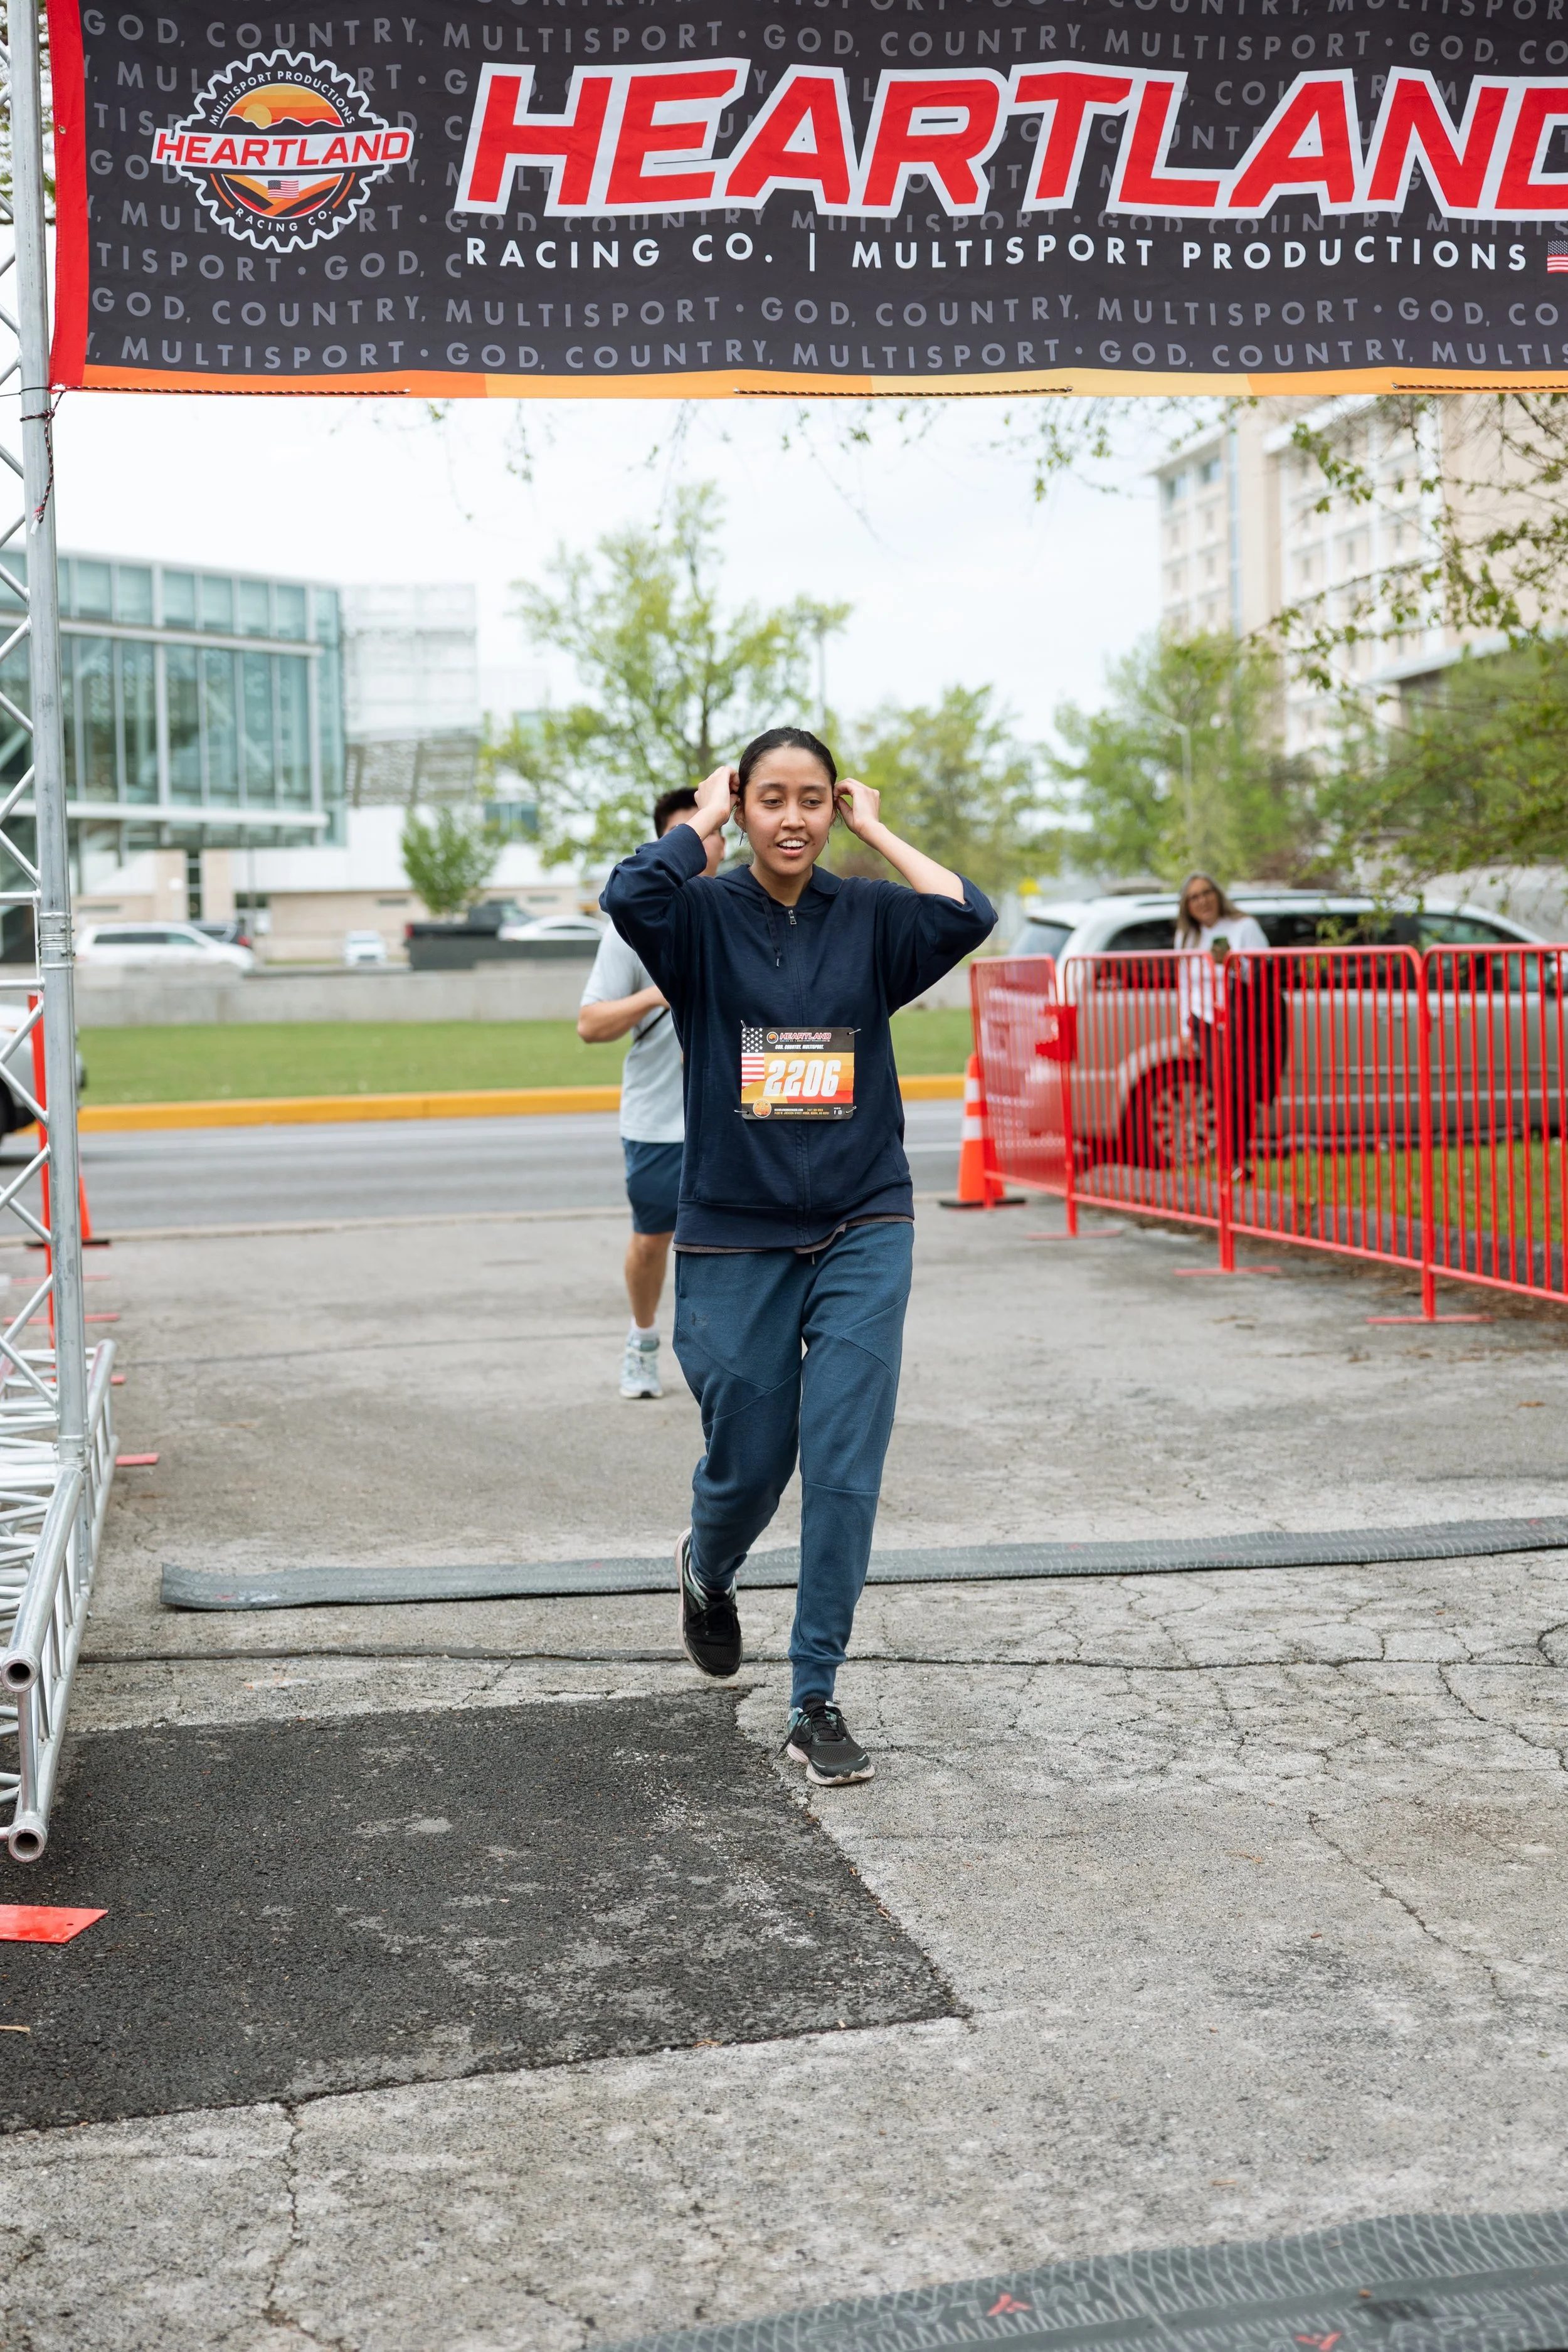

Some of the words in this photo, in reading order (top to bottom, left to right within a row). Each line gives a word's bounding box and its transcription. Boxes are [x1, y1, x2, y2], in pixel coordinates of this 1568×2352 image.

[83, 9, 186, 48] GOD,
[206, 17, 425, 50] COUNTRY,
[443, 21, 723, 54] MULTISPORT
[763, 24, 861, 58] GOD,
[880, 23, 1087, 57] COUNTRY,
[1104, 28, 1372, 61] MULTISPORT
[1409, 31, 1500, 65] GOD,
[209, 71, 272, 126] MULTISPORT
[277, 70, 356, 124] PRODUCTIONS
[155, 131, 411, 167] HEARTLAND
[235, 207, 298, 233] RACING
[308, 210, 332, 226] CO.
[96, 241, 282, 282] TISPORT
[324, 250, 425, 280] GOD,
[467, 237, 660, 269] RACING
[692, 232, 773, 263] CO.
[852, 233, 1153, 270] MULTISPORT
[1182, 235, 1527, 272] PRODUCTIONS
[92, 287, 191, 324] GOD,
[211, 295, 425, 327] COUNTRY,
[445, 296, 721, 327] MULTISPORT
[761, 297, 856, 328] GOD,
[876, 294, 1079, 327] COUNTRY,
[1098, 297, 1359, 326] MULTISPORT
[1398, 297, 1491, 327] GOD,
[120, 336, 405, 369] MULTISPORT
[446, 342, 546, 370] GOD,
[565, 339, 774, 369] COUNTRY,
[793, 339, 1060, 369] MULTISPORT
[1099, 340, 1194, 368] GOD,
[1212, 339, 1413, 368] COUNTRY,
[763, 1059, 842, 1097] 2206
